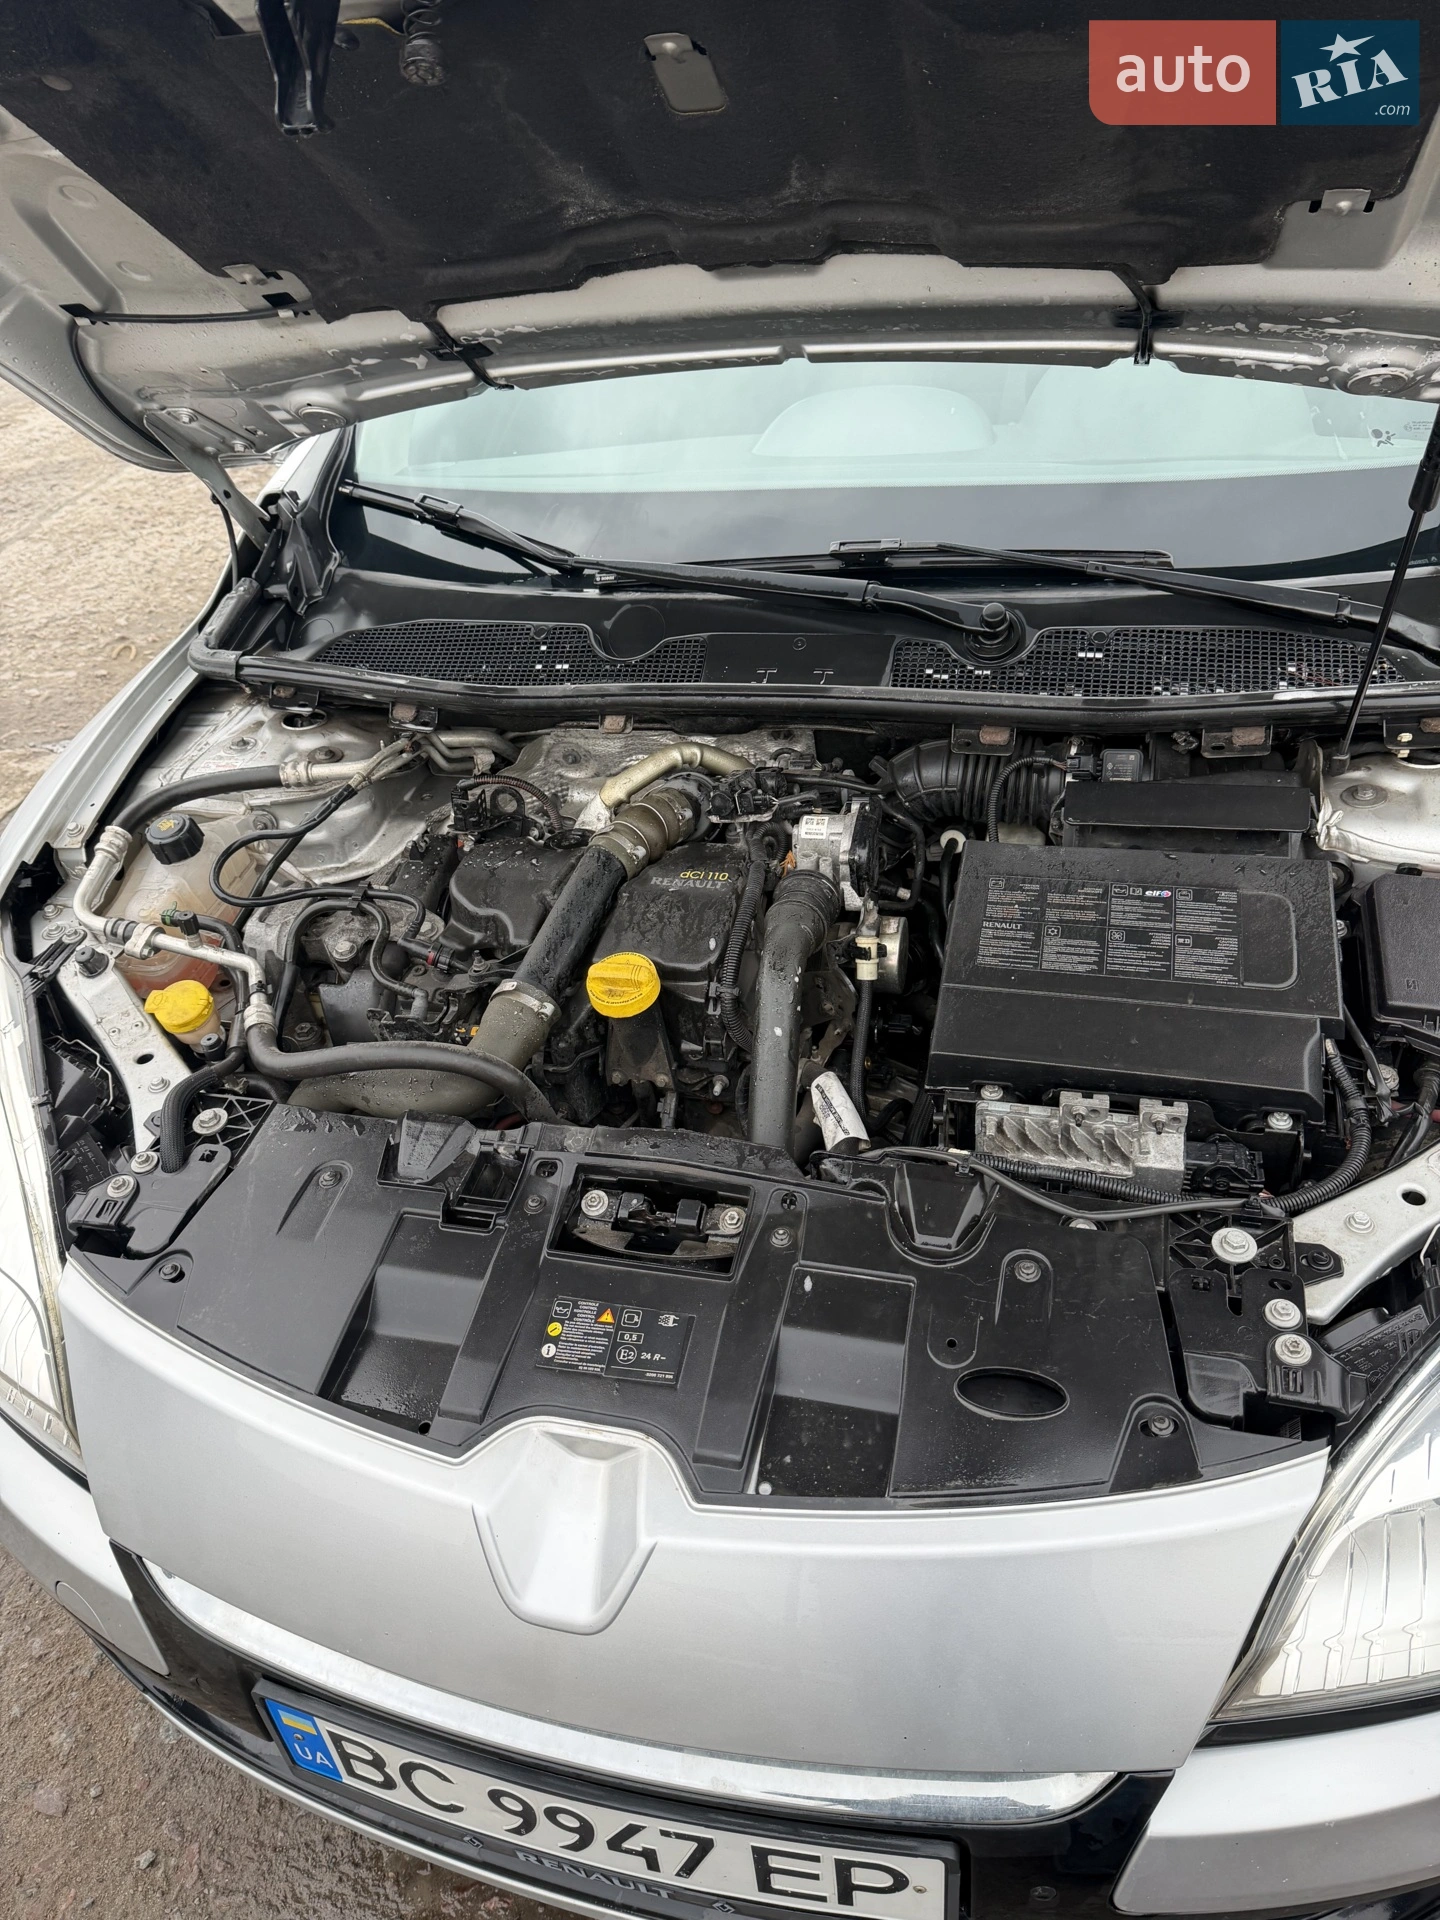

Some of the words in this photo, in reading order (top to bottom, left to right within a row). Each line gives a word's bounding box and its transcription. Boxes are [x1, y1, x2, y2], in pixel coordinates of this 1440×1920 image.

[707, 871, 729, 881] 110
[650, 877, 727, 888] RENAULT
[982, 920, 1023, 930] RENAULT
[619, 1349, 634, 1360] E2
[292, 1743, 334, 1770] UA
[325, 1728, 465, 1815] BC
[487, 1788, 715, 1877] 9947
[749, 1844, 910, 1907] EP
[514, 1848, 678, 1901] RENAULT
